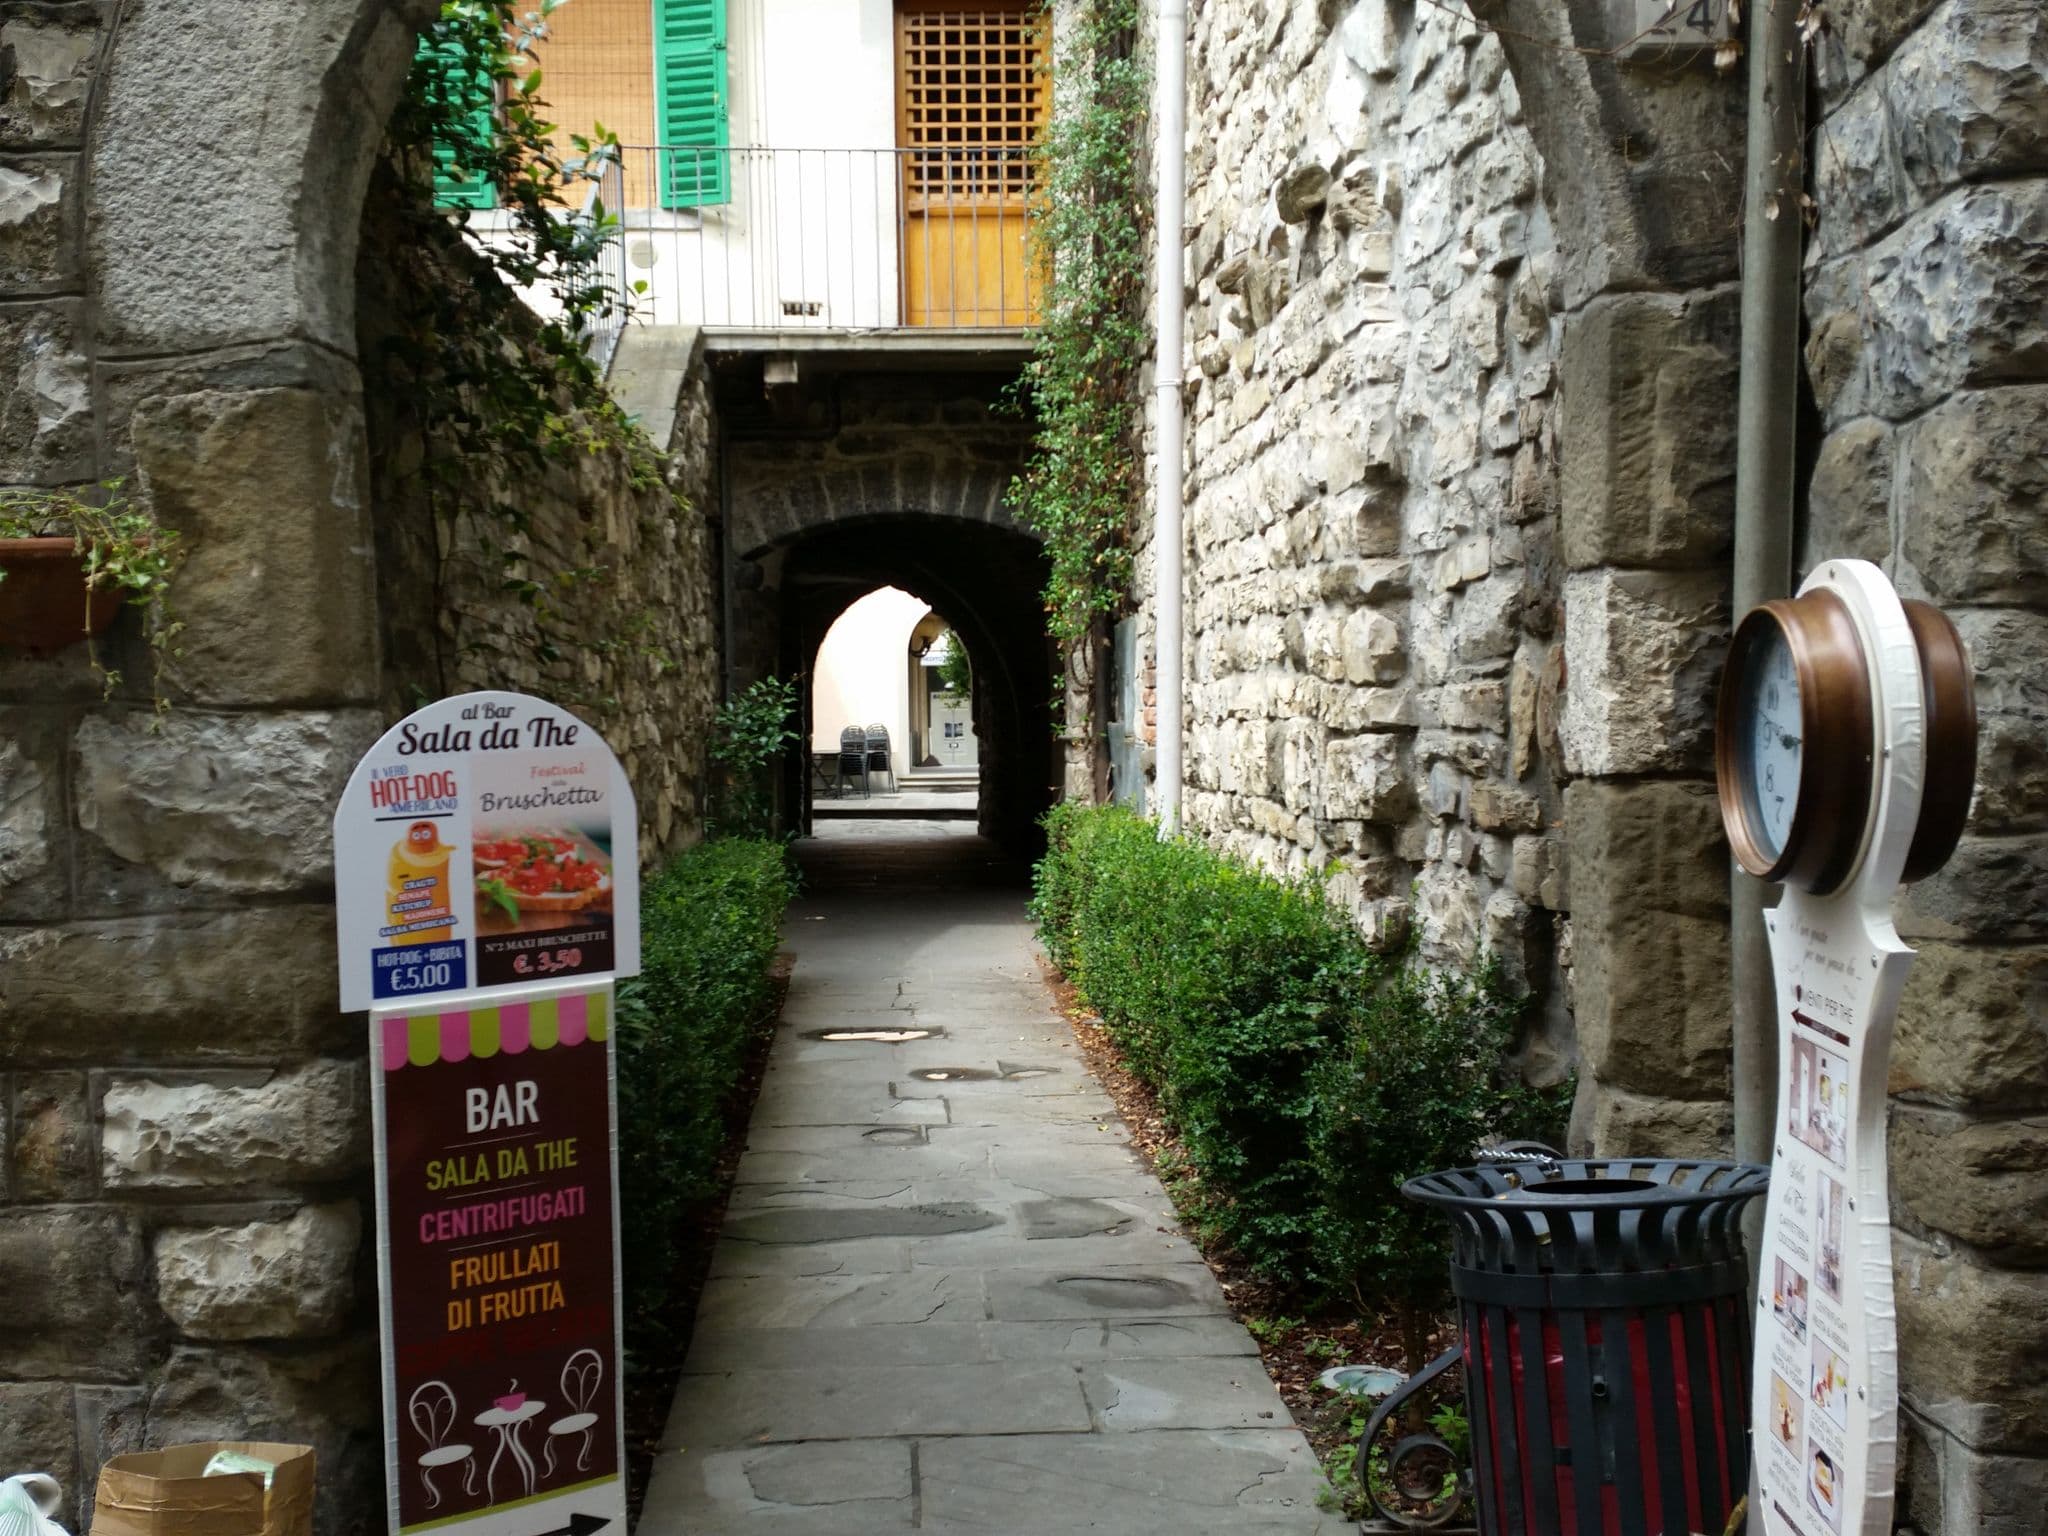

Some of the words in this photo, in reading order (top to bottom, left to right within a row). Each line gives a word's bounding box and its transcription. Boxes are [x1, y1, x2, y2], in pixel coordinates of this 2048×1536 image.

[461, 704, 478, 720] al
[481, 701, 515, 719] Bar
[398, 722, 471, 755] Sala
[479, 720, 518, 750] da
[527, 716, 578, 747] The
[370, 769, 457, 809] HOT-DOG
[529, 761, 586, 779] Festival
[480, 786, 604, 812] Bruschetta
[377, 950, 422, 968] HOT-DOG
[429, 946, 463, 962] BIBITA
[537, 930, 608, 947] BRUSCHETTE
[466, 1080, 540, 1134] BAR
[426, 1152, 490, 1190] SALA
[497, 1145, 530, 1180] DA
[534, 1137, 579, 1172] THE
[419, 1186, 586, 1244] CENTRIFUGATI
[450, 1241, 560, 1290] FRULLATI
[448, 1300, 472, 1332] DI
[480, 1280, 566, 1325] FRUTTA
